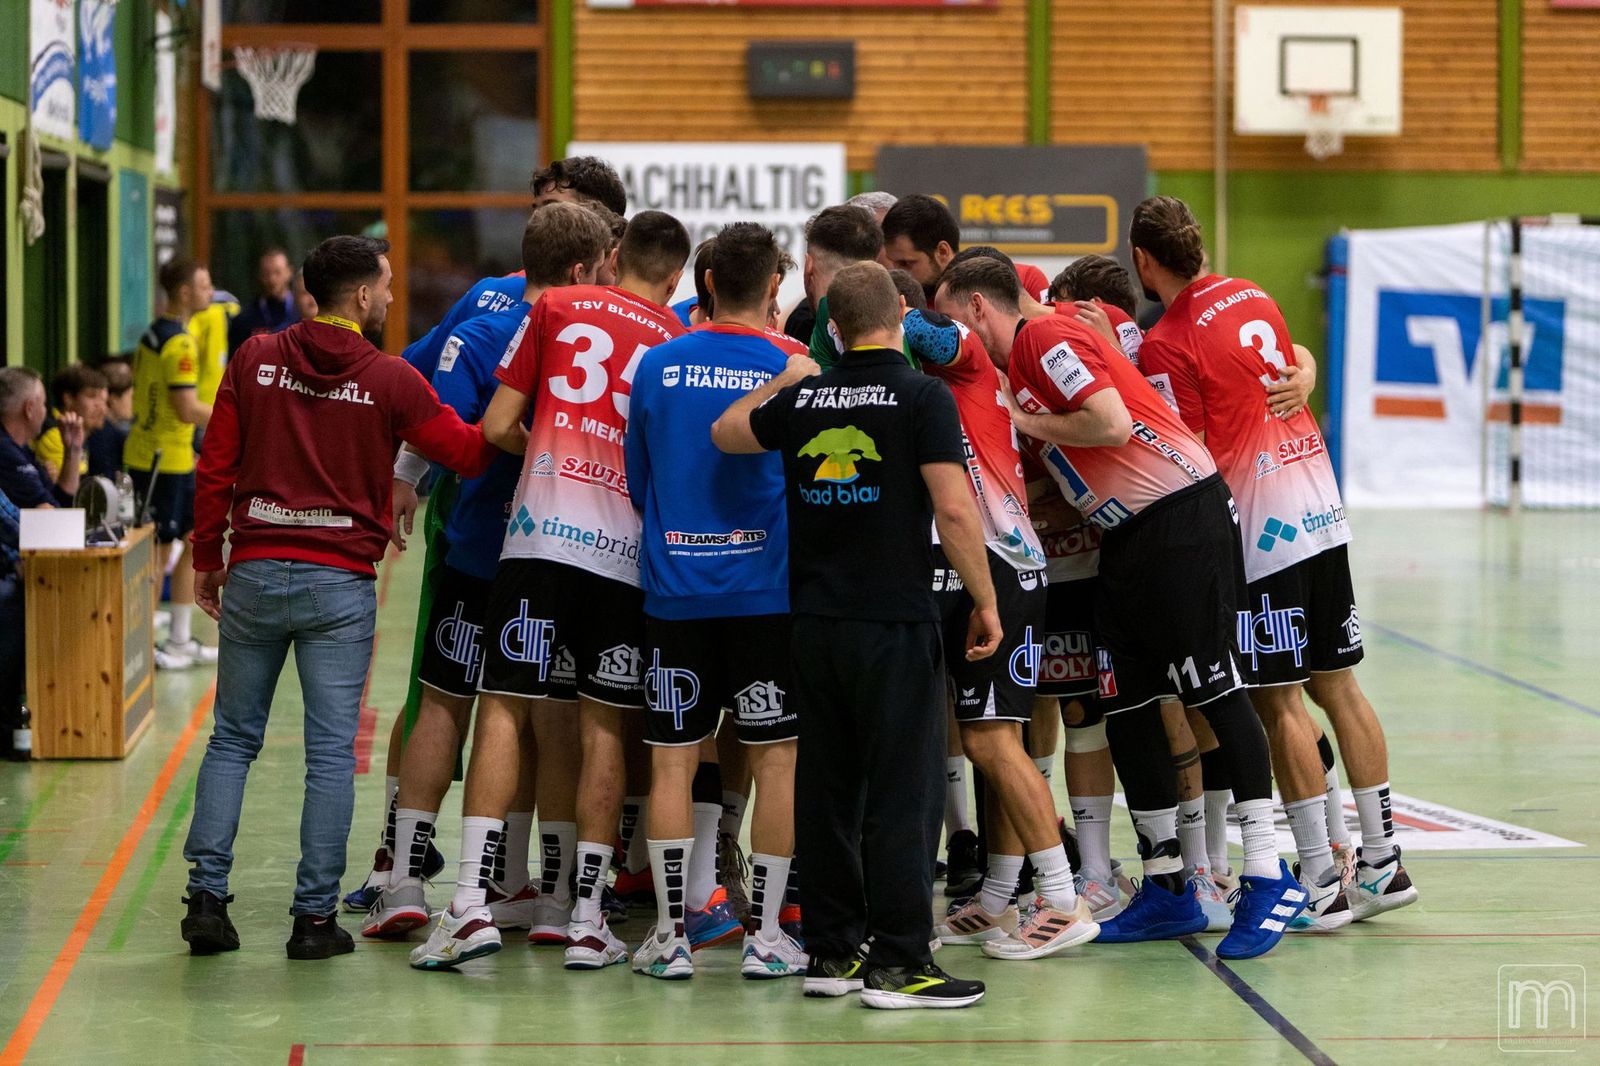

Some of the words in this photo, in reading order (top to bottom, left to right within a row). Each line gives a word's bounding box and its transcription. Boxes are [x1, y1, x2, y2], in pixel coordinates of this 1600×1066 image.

[495, 291, 515, 306] TSV
[571, 300, 604, 311] TSV
[1196, 306, 1218, 328] TSV
[1215, 288, 1270, 312] BLAUSTEIN
[1046, 348, 1068, 370] DHB
[1238, 319, 1288, 387] 3
[684, 364, 712, 376] TSV
[714, 366, 773, 381] Blaustein
[684, 373, 768, 392] HANDBA
[1061, 367, 1081, 388] HBW
[811, 391, 899, 410] HANDBALL
[815, 386, 838, 398] TSV
[839, 384, 887, 397] Blaustein
[554, 411, 574, 431] D.
[798, 482, 833, 506] bad
[836, 483, 881, 506] blau
[250, 496, 333, 519] förderverein
[1166, 655, 1202, 694] 11
[739, 680, 781, 713] RSt
